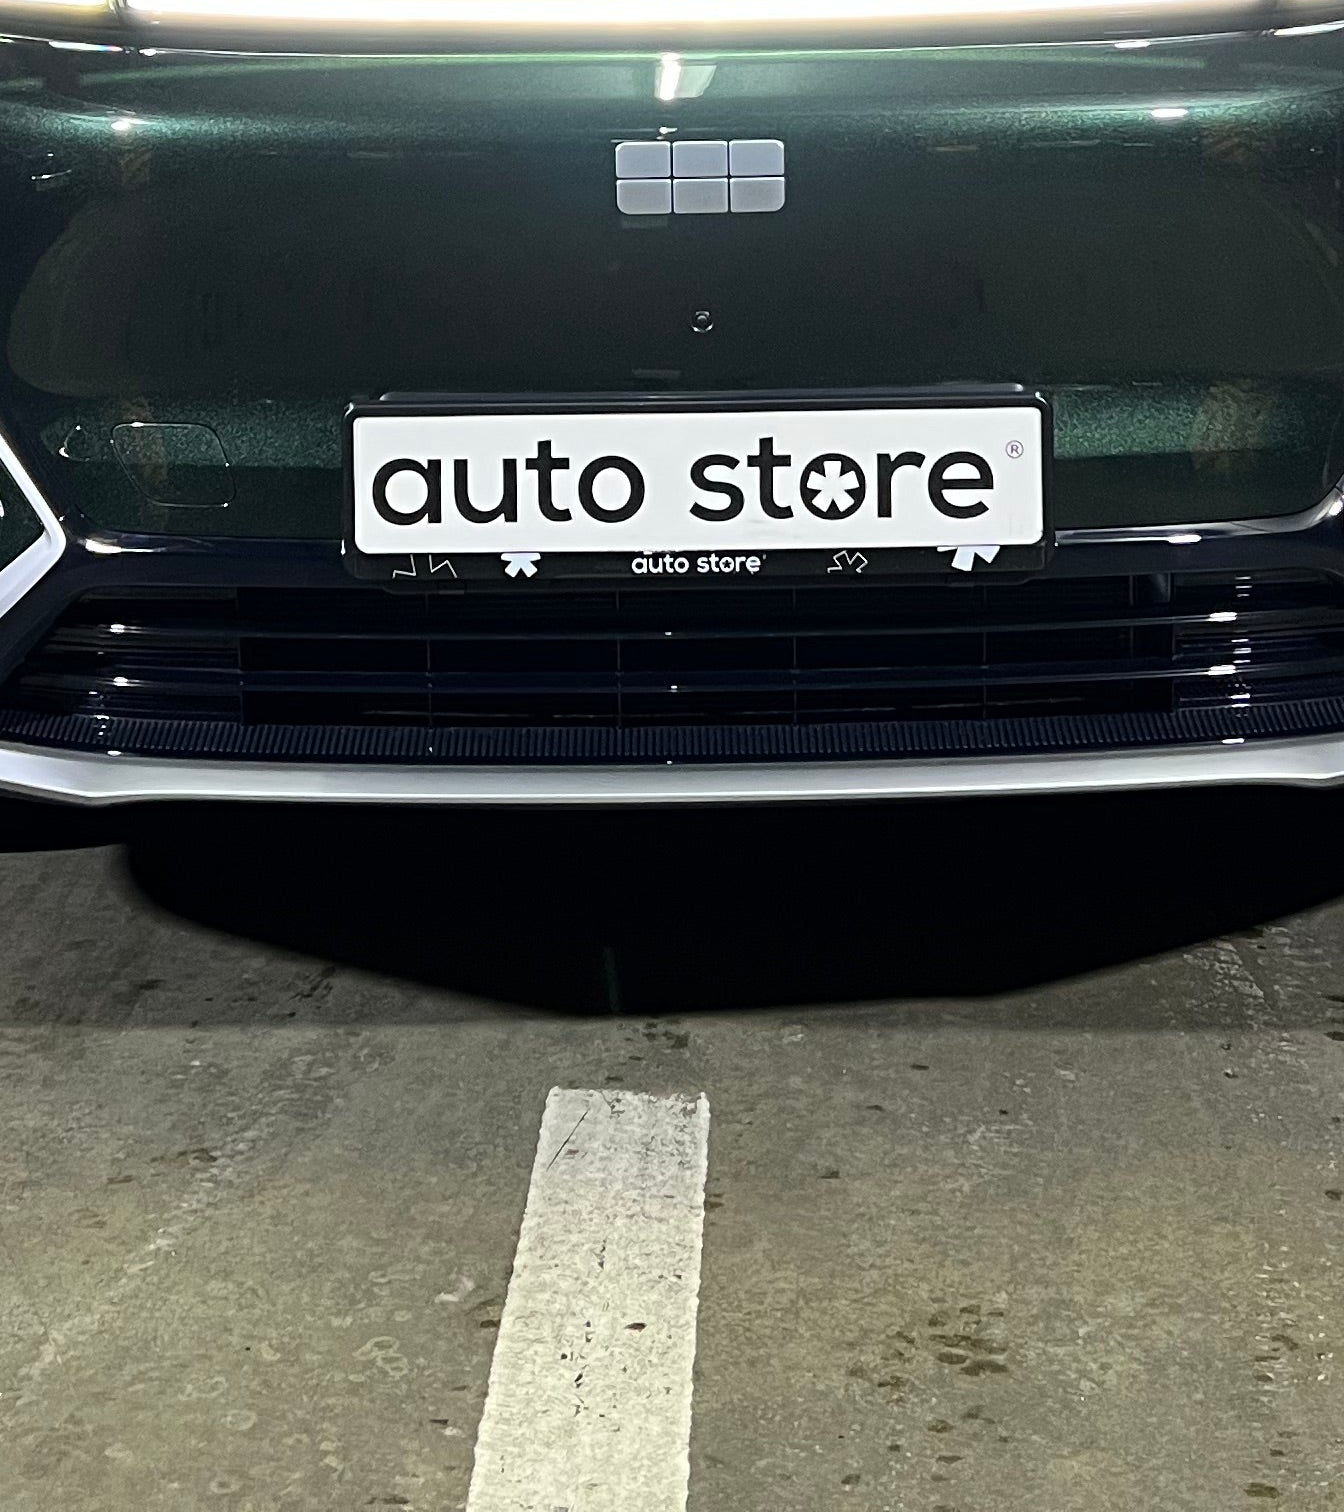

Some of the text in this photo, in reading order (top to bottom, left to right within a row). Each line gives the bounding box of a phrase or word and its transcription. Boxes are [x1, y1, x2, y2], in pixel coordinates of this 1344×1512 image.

[371, 439, 646, 526] auto
[688, 436, 995, 522] store
[631, 553, 762, 574] auto store
